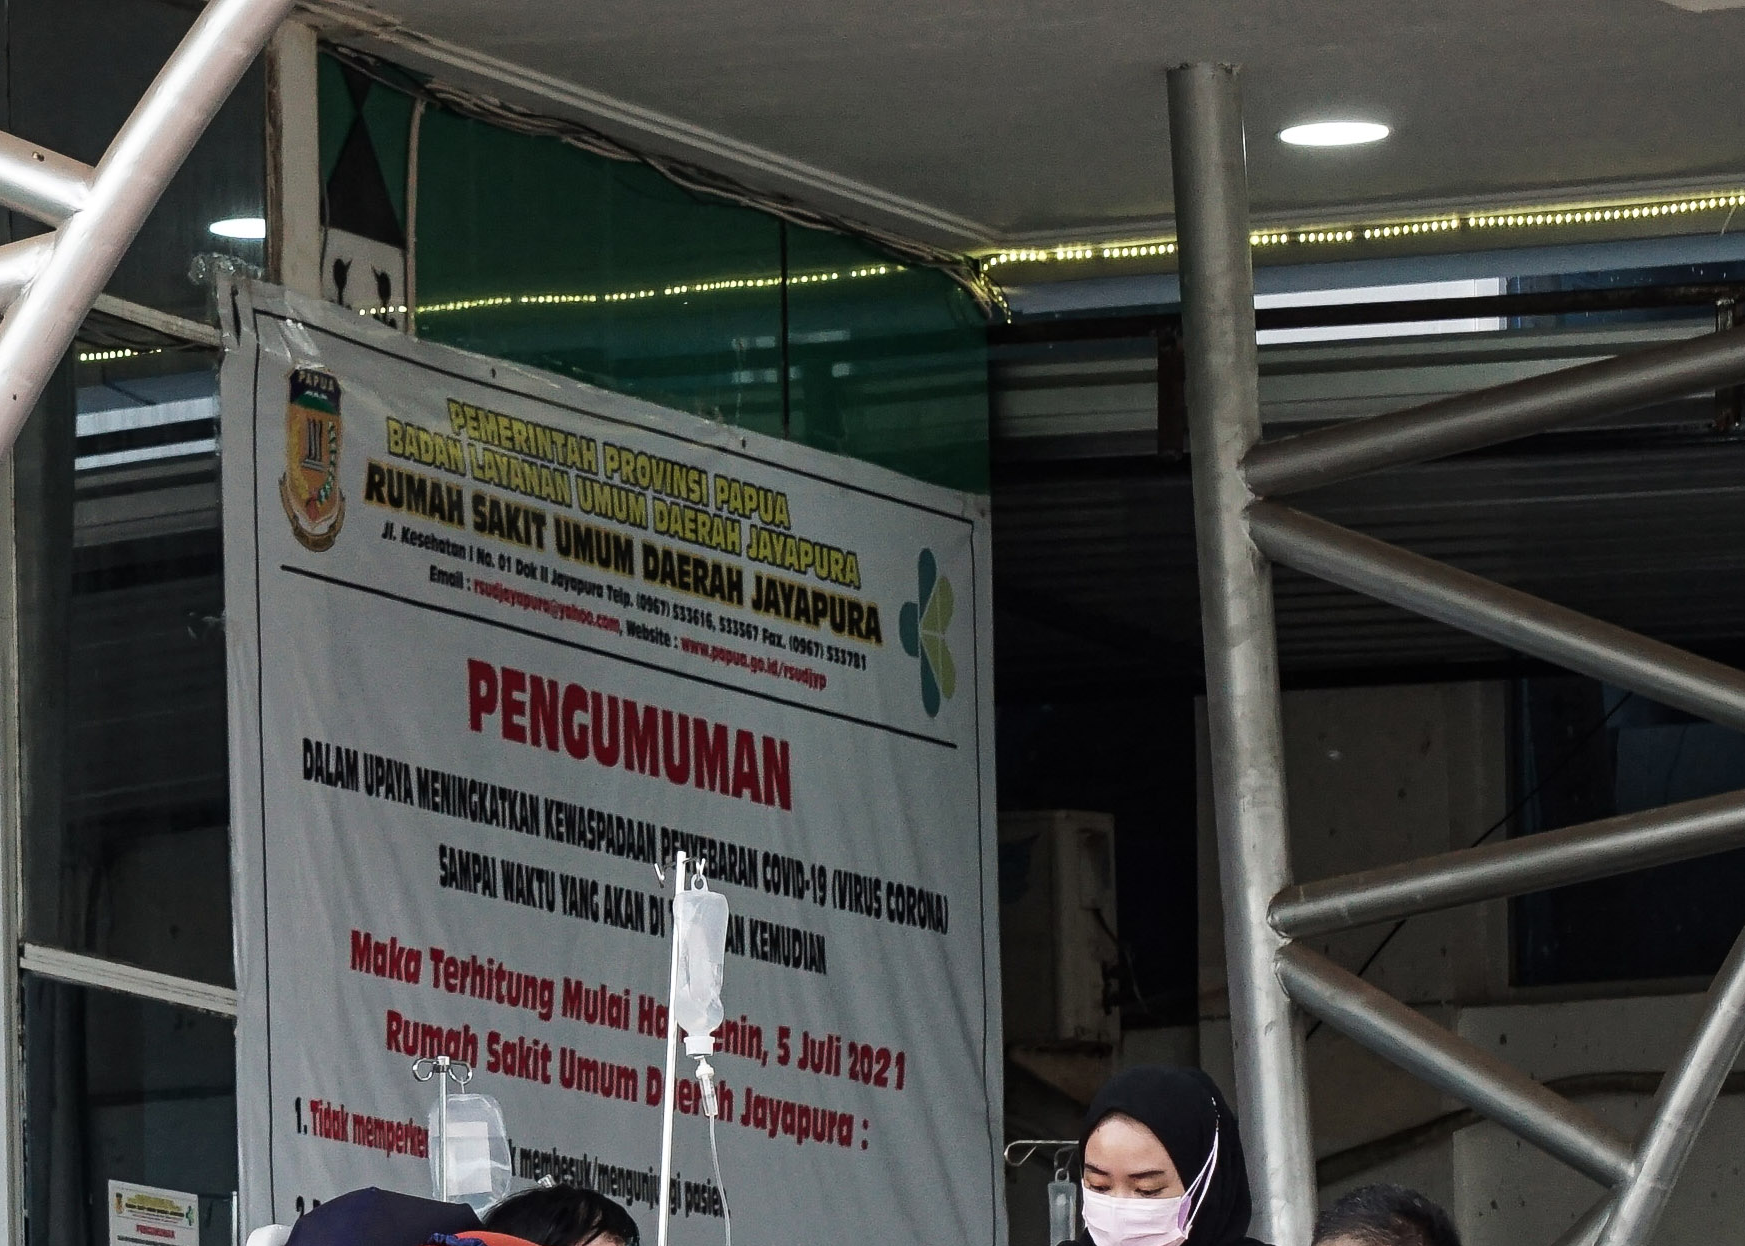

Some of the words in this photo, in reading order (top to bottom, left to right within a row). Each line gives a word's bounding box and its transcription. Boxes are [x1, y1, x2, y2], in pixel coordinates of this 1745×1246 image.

[298, 369, 337, 394] PAPUA
[386, 419, 466, 477] BADAN
[469, 443, 572, 507] LAYANAN
[576, 473, 648, 529] UMUM
[652, 494, 742, 555] DAERAH
[747, 521, 861, 589] JAYAPURA
[447, 398, 599, 476] PEMERINTAH
[602, 442, 710, 506] PROVINSI
[713, 473, 791, 528] PAPUA
[364, 464, 465, 530] RUMAH
[471, 493, 547, 553] SAKIT
[553, 515, 635, 576] UMUM
[641, 539, 744, 606] DAERAH
[750, 569, 883, 644] JAYAPURA
[467, 659, 792, 810] PENGUMUMAN
[301, 737, 360, 794] DALAM
[362, 752, 414, 807] UPAYA
[415, 765, 541, 837] MENINGKATKAN
[543, 796, 658, 865] KEWASPADAAN
[761, 849, 828, 905] COVID-19
[831, 865, 883, 918] (VIRUS
[885, 879, 949, 934] CORONA)
[439, 845, 496, 898] SAMPAI
[501, 857, 556, 913] WAKTU
[560, 870, 600, 924] YANG
[604, 883, 646, 933] AKAN
[649, 894, 666, 938] DI
[750, 918, 828, 975] KEMUDIAN
[351, 930, 422, 984] Maka
[430, 948, 555, 1019] Terhitung
[561, 978, 632, 1032] Mulai
[777, 1025, 791, 1067] 5
[798, 1031, 842, 1077] Juli
[848, 1041, 906, 1091] 2021
[386, 1010, 479, 1070] Rumah
[486, 1032, 552, 1087] Sakit
[559, 1047, 638, 1103] Umum
[740, 1086, 855, 1148] Jayapura
[295, 1096, 309, 1135] 1.
[309, 1099, 350, 1143] Tidak
